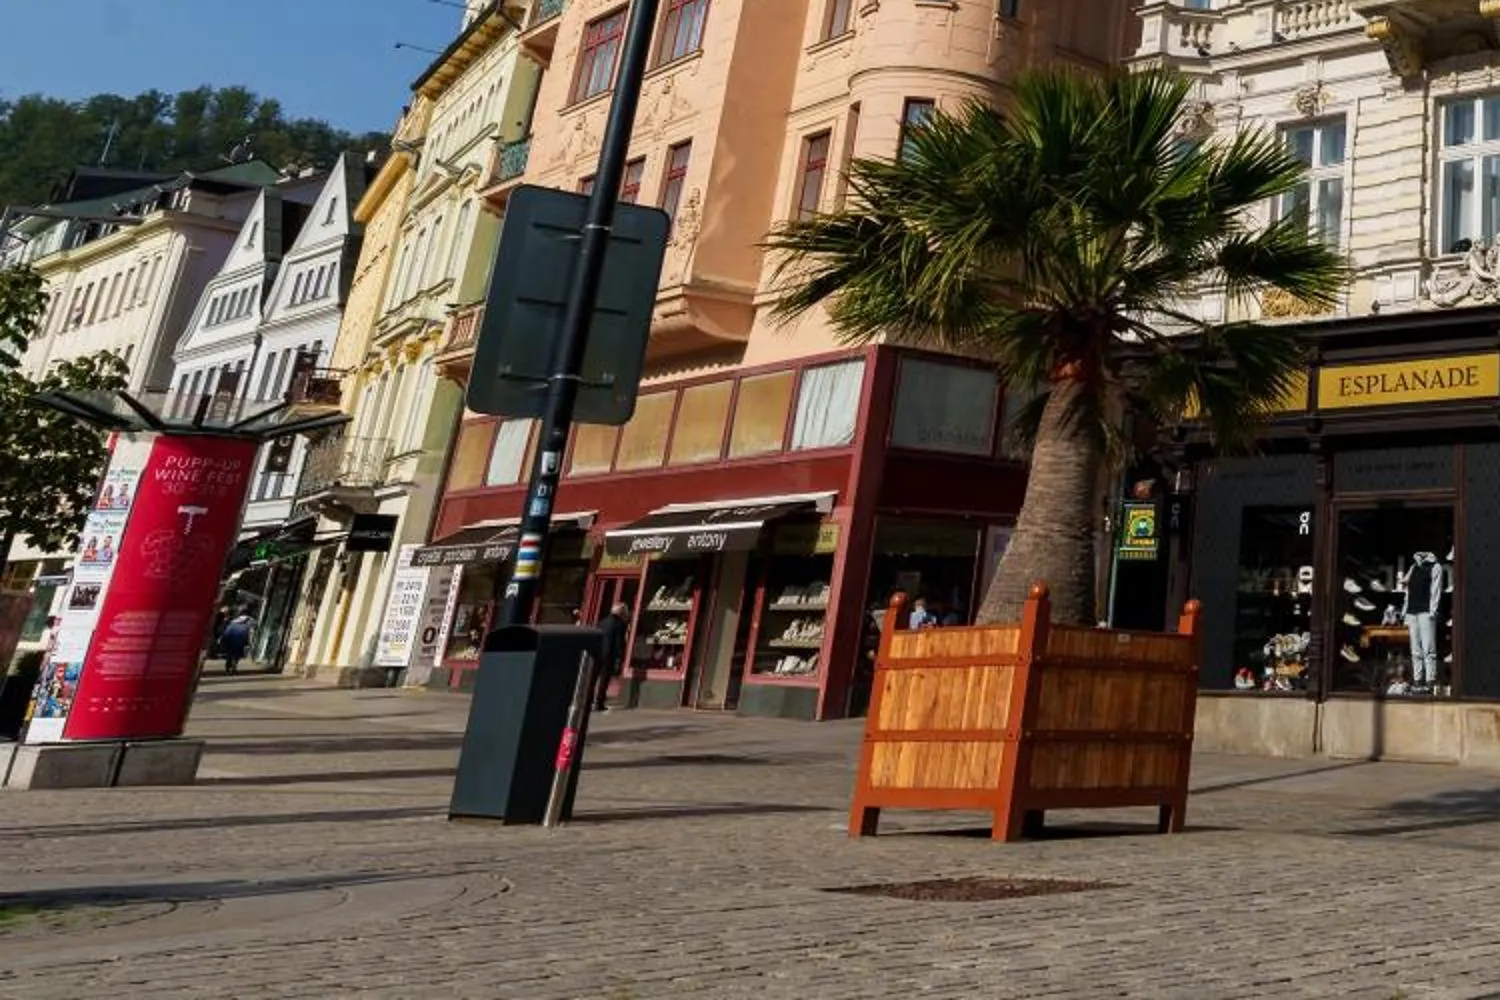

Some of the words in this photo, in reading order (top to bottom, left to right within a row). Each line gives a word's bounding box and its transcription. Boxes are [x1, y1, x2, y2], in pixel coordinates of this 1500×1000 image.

[1339, 366, 1480, 397] ESPLANADE
[155, 468, 202, 483] WINE
[687, 533, 728, 551] antony
